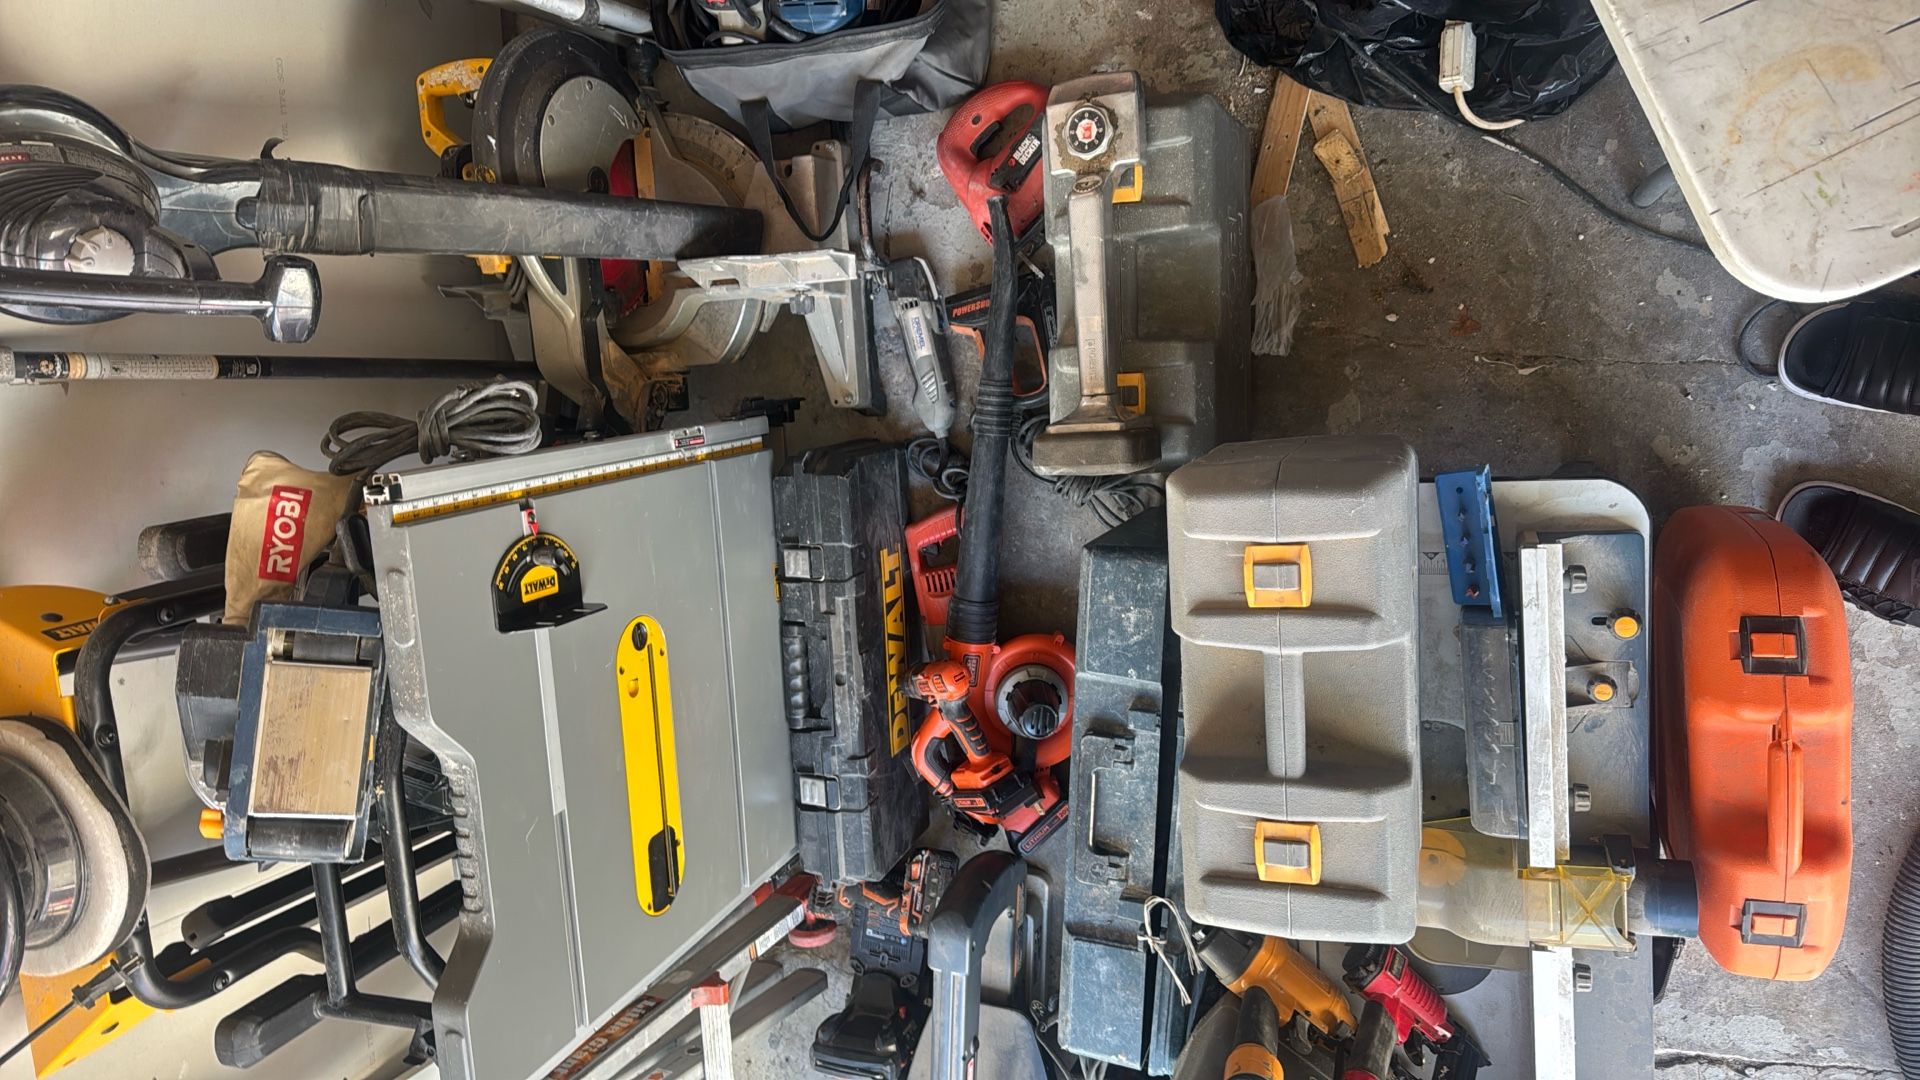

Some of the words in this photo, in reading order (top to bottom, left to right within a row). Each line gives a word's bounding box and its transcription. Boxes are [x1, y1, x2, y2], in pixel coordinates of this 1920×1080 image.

[1019, 138, 1041, 166] DECKER
[952, 299, 992, 318] POWERSHO
[914, 317, 926, 350] DREMEL
[267, 491, 303, 573] RYOBI
[524, 575, 556, 594] DEWALT
[881, 549, 908, 756] DEWALT
[1024, 825, 1050, 851] LITHIUM
[605, 999, 656, 1035] Little
[554, 1036, 608, 1075] Giant
